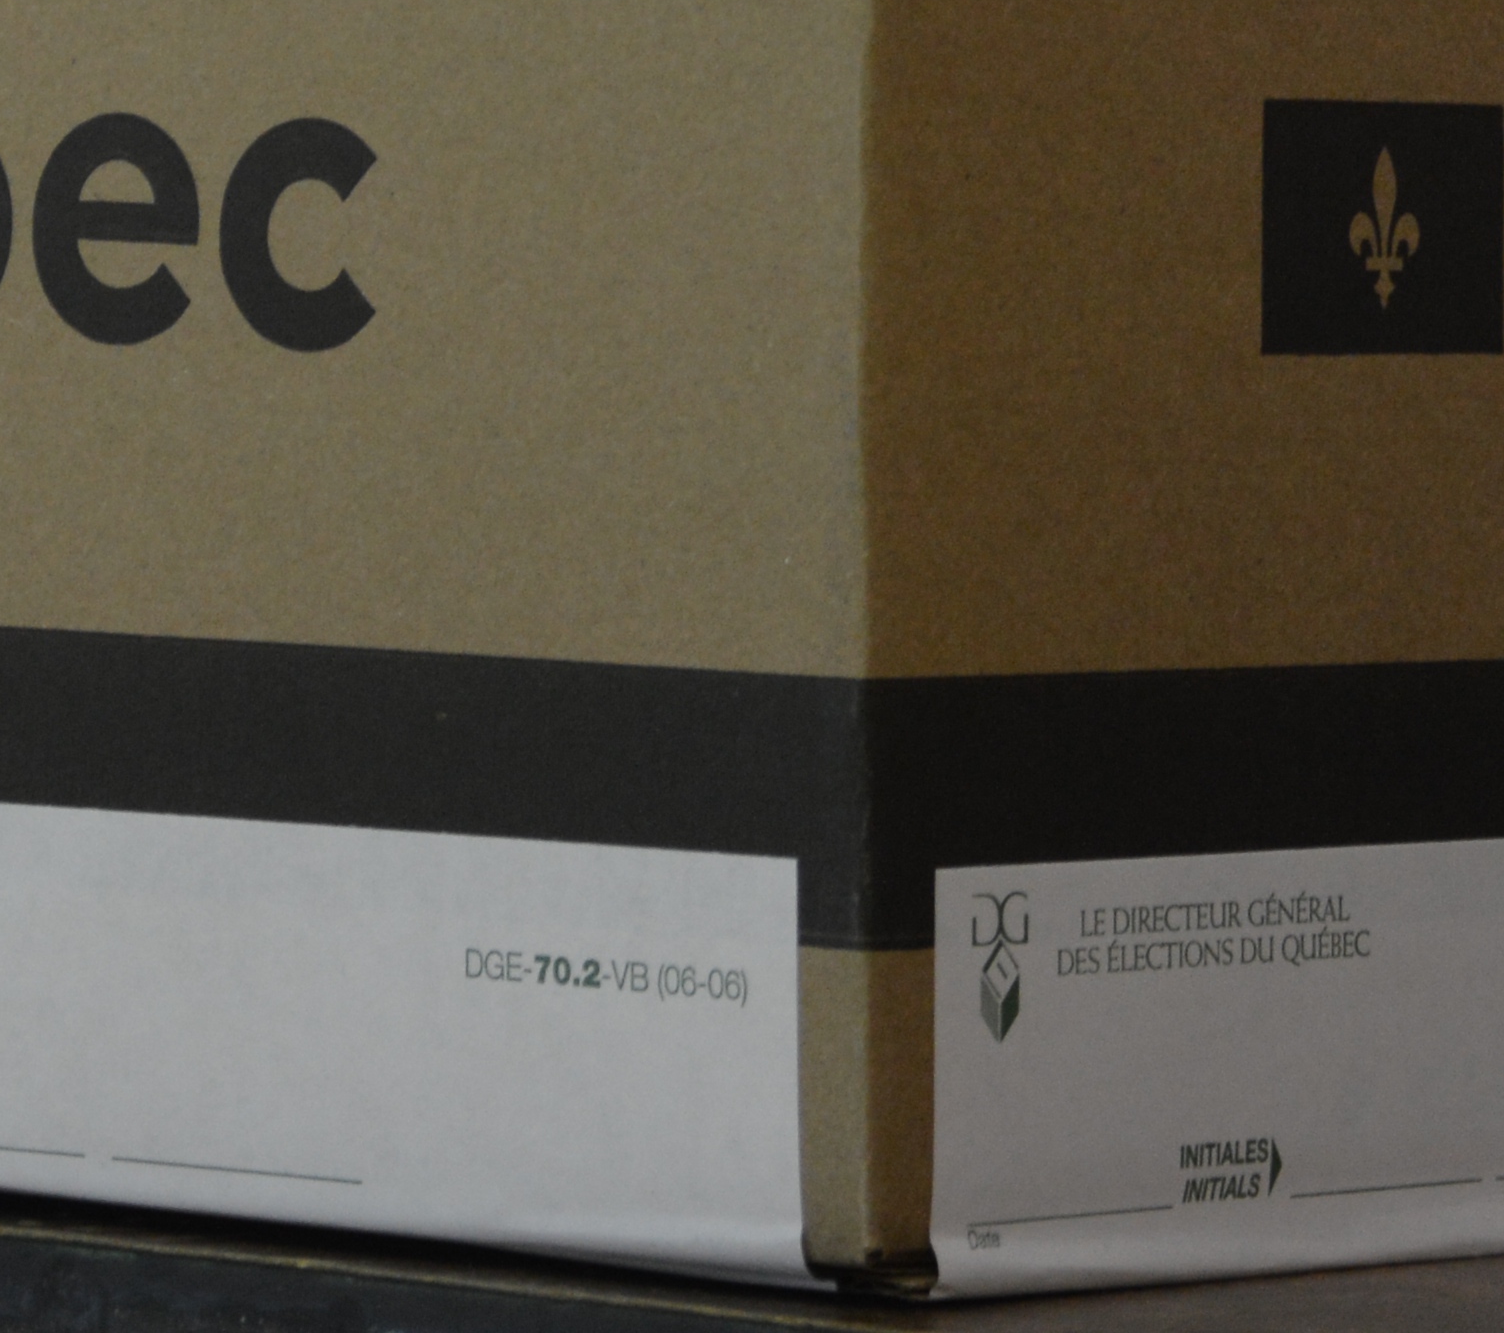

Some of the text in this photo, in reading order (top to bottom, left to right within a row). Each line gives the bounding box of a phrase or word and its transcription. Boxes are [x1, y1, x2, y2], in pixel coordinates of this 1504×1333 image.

[1080, 891, 1351, 938] LE DIRECTEUR GÉNÉRAL
[1056, 927, 1371, 977] DES ÉLECTIONS DU QUÉBEC
[464, 947, 748, 1009] DGE-70.2-VB (06-06)
[1179, 1137, 1269, 1169] INITIALES
[1182, 1173, 1261, 1204] INITIALS
[966, 1229, 1001, 1251] Date
